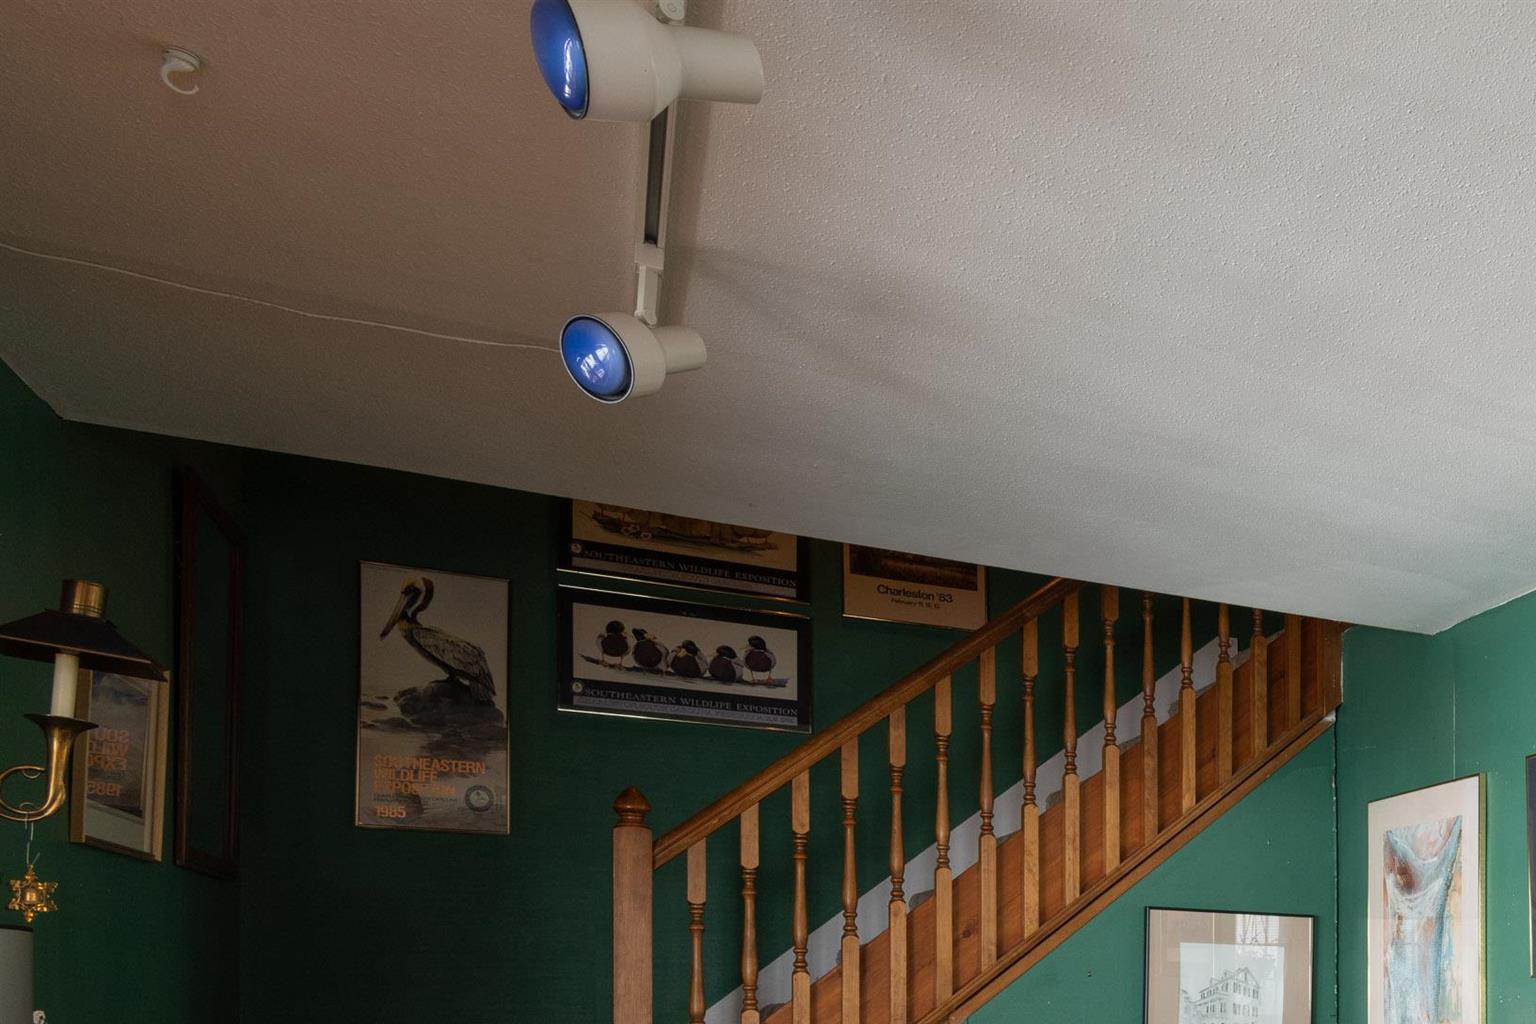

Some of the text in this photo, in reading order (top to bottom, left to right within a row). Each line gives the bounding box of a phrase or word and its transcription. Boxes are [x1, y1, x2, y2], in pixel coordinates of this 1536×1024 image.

[678, 562, 731, 578] WILDLIFE
[734, 570, 797, 587] EXPOSITION
[877, 583, 934, 601] Charleston
[584, 687, 677, 704] SOUTHEASTERN
[679, 697, 731, 710] WILDLIFE
[735, 703, 799, 716] EXPOSITION
[374, 753, 486, 775] SOUTHEASTERN
[374, 767, 439, 783] WILDLIFE
[375, 804, 406, 818] 1985
